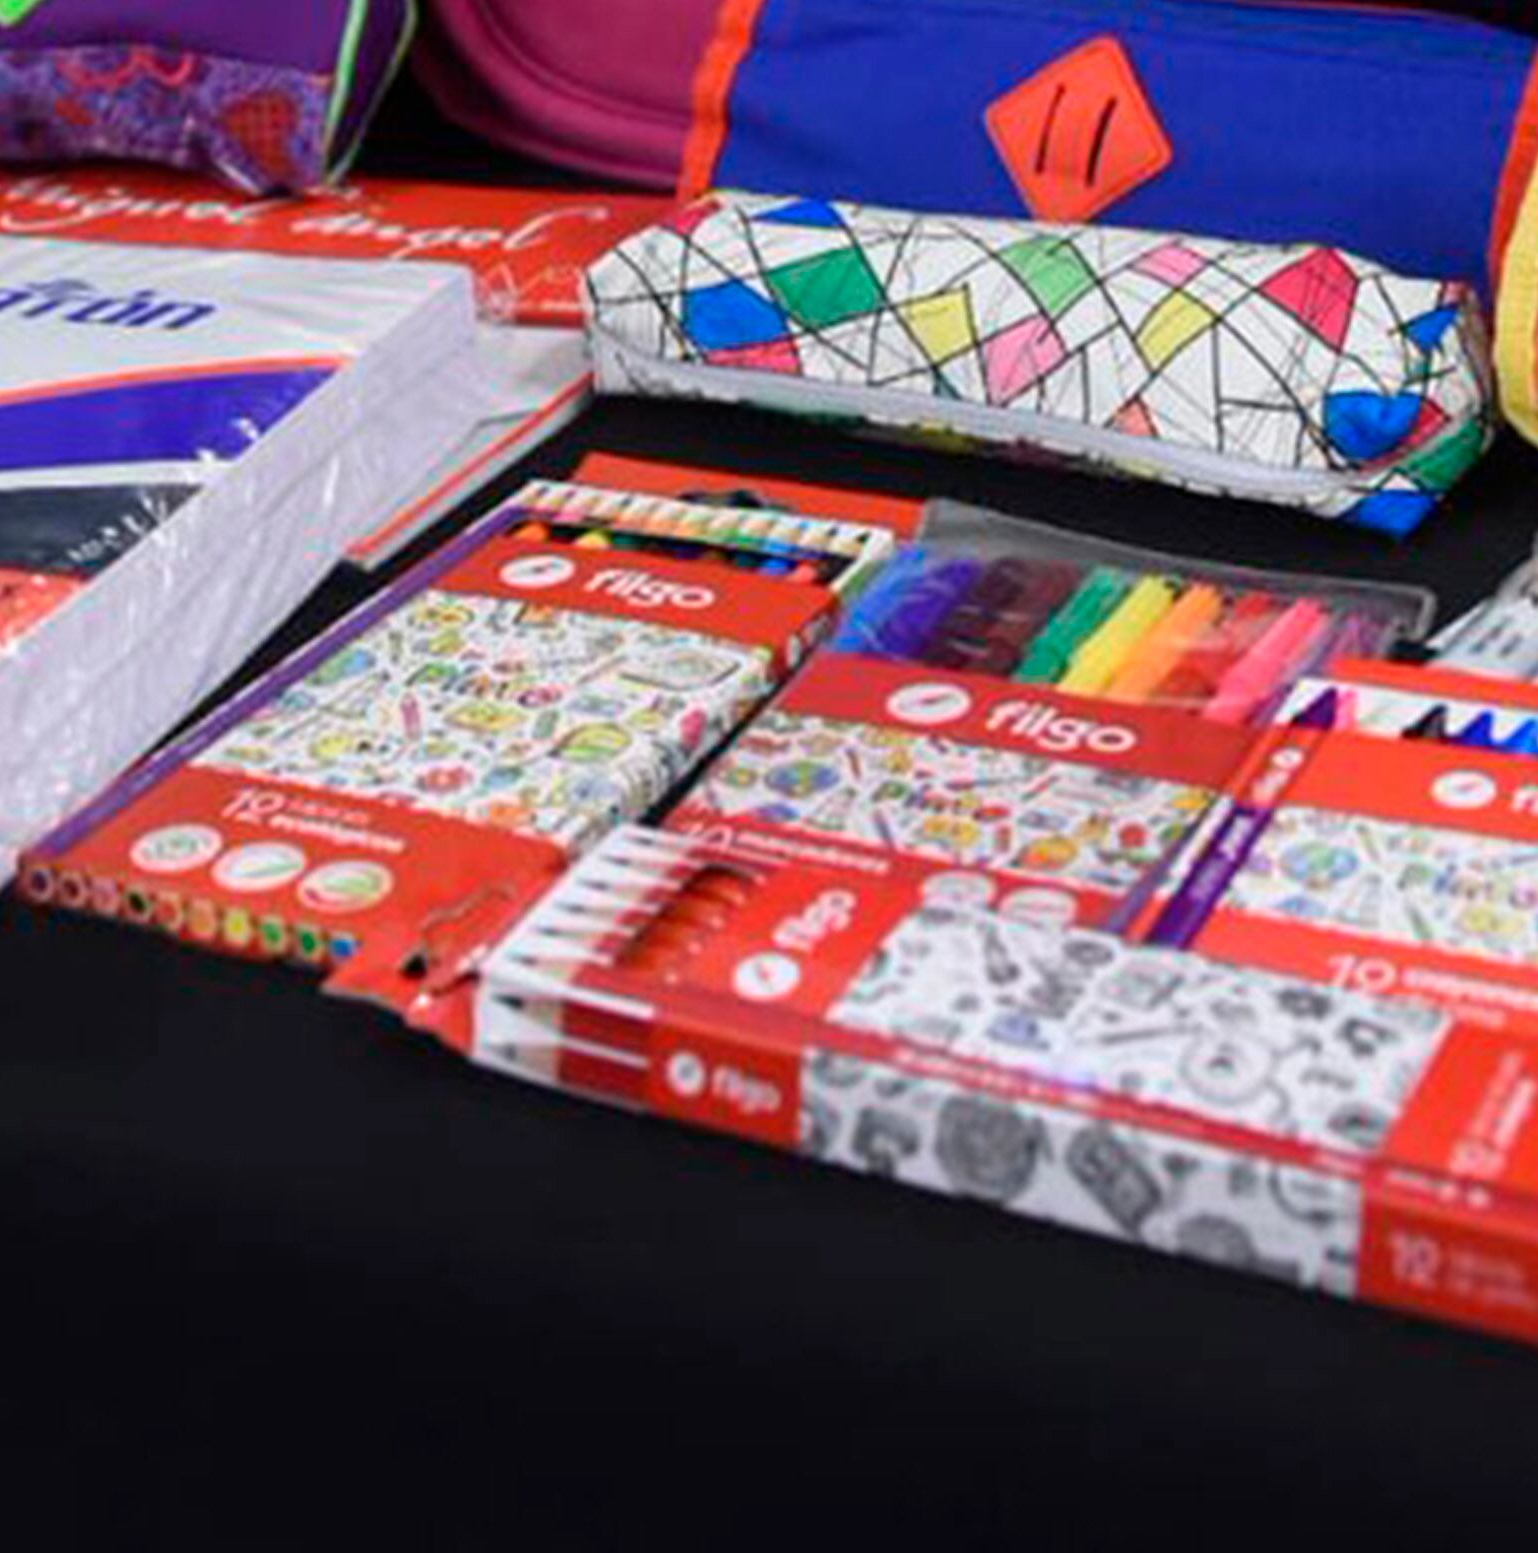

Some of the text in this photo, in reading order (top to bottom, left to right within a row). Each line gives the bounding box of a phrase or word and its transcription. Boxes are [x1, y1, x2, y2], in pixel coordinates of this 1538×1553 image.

[581, 565, 717, 611] filgo
[984, 699, 1139, 754] filgo
[1327, 953, 1397, 992] 10
